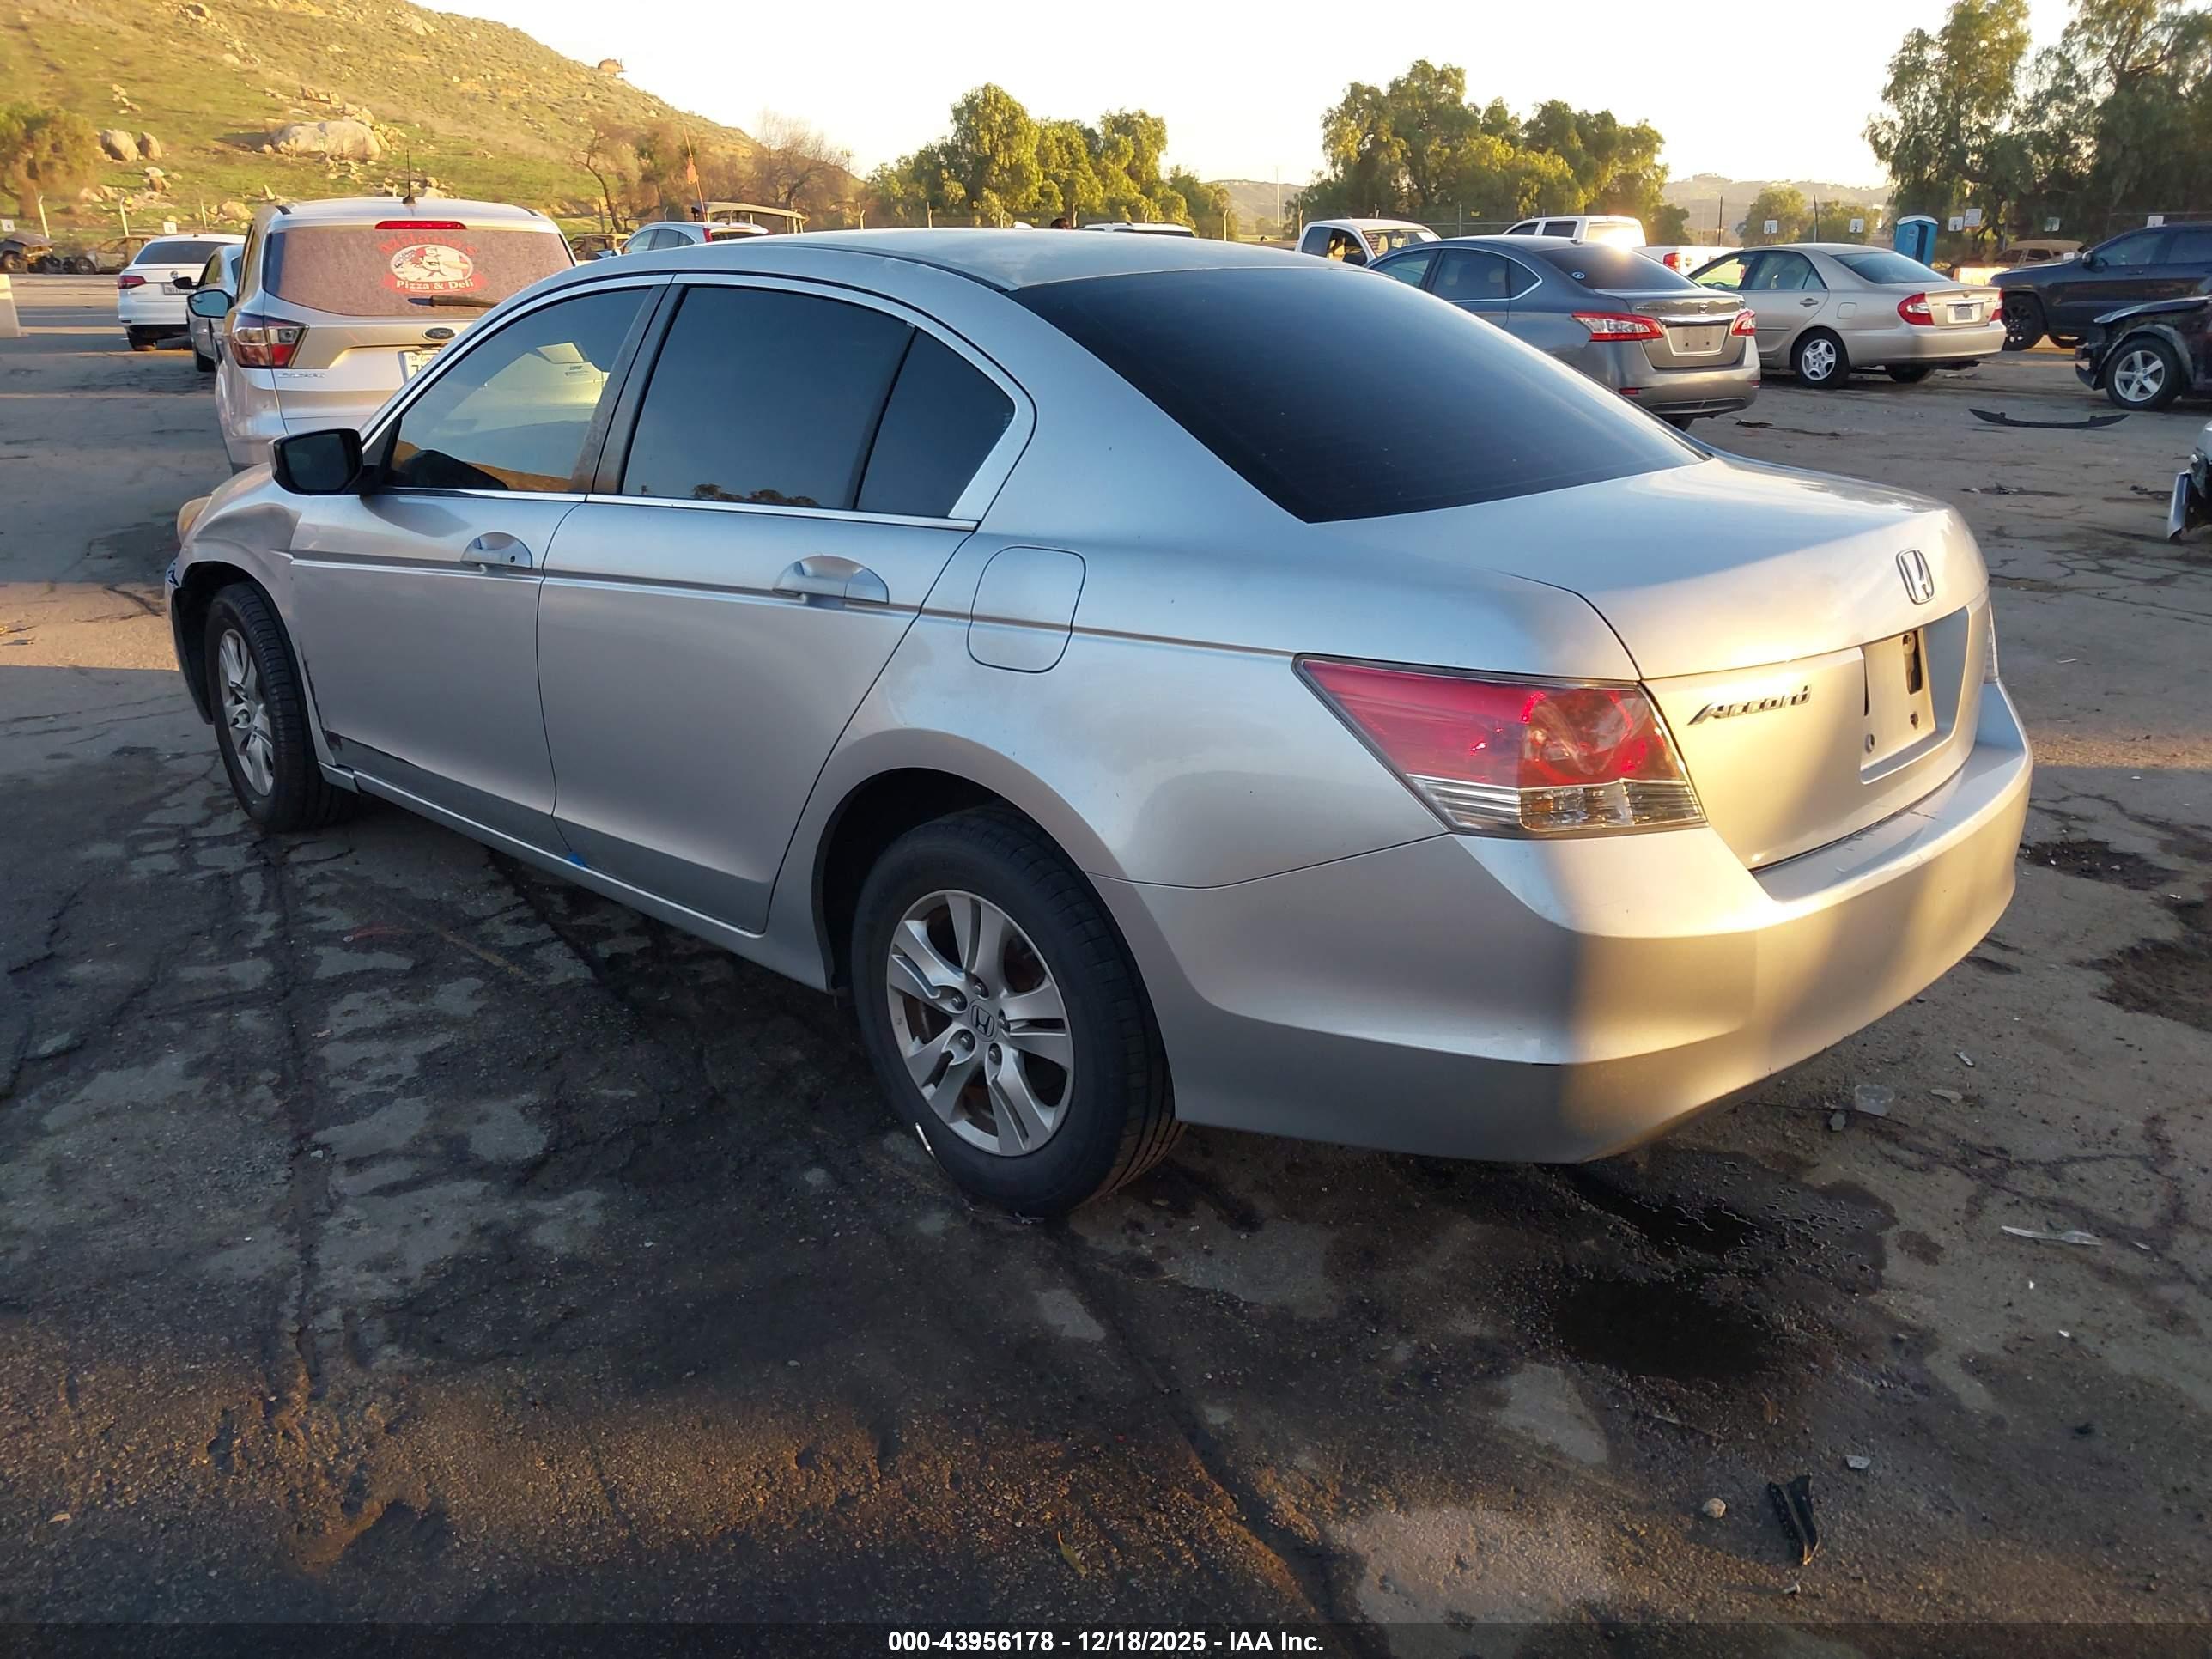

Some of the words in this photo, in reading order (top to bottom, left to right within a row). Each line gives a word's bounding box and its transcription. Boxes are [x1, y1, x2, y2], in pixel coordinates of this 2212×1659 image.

[396, 279, 430, 290] Pizza
[434, 280, 445, 290] &
[448, 277, 475, 289] Deli
[1687, 684, 1812, 726] Accord
